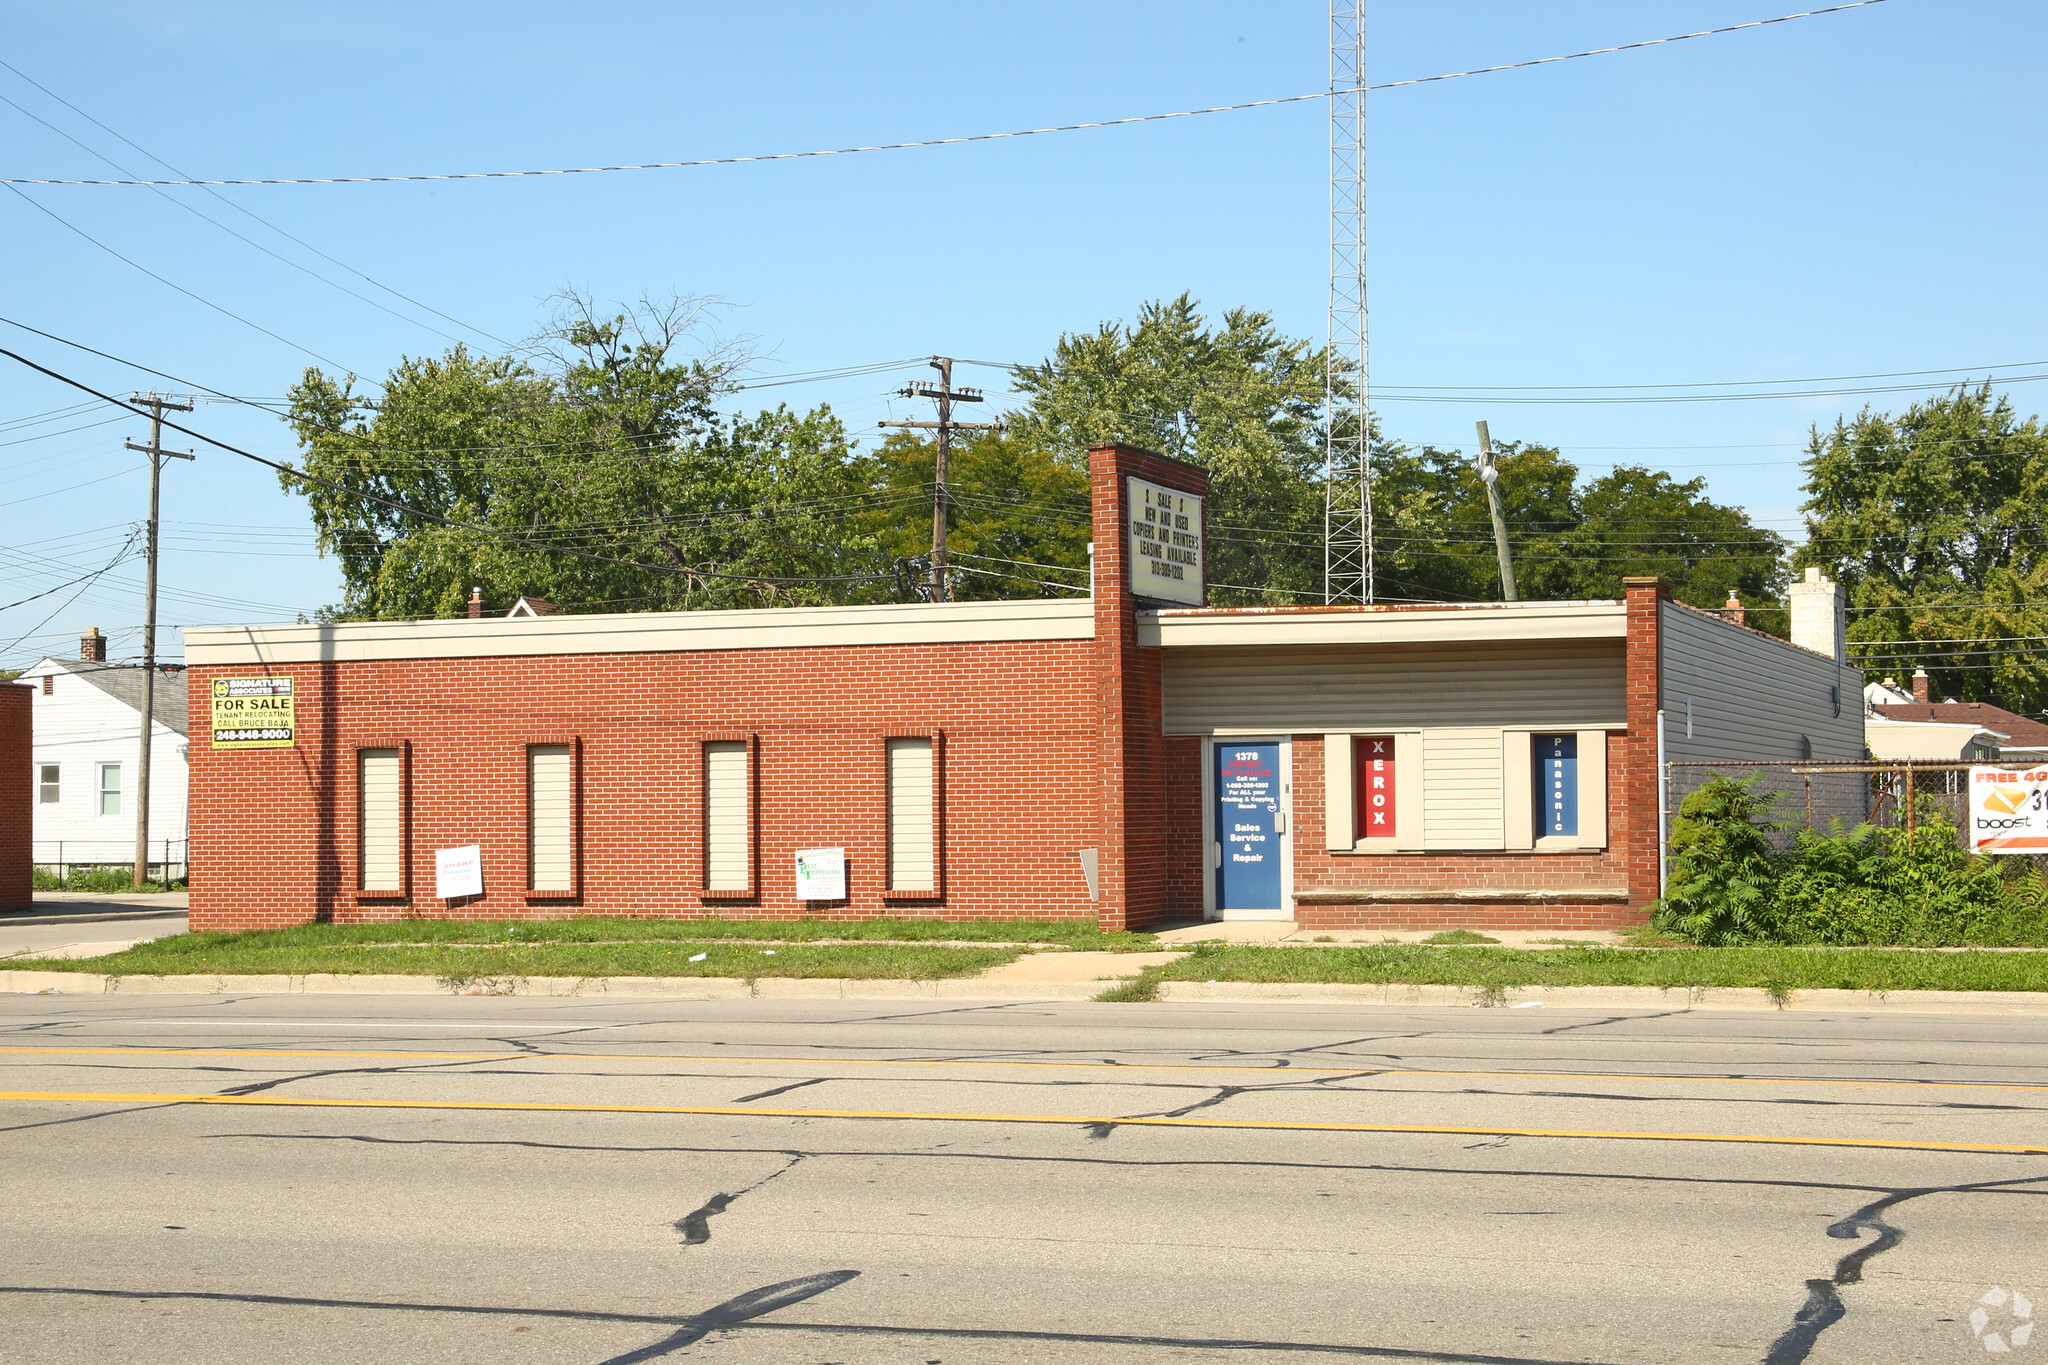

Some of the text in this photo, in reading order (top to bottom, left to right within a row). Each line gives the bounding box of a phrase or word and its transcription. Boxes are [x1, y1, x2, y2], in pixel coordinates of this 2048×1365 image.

[1158, 492, 1172, 509] SALE
[1145, 506, 1188, 531] NEW AND USED
[1133, 520, 1199, 550] COPIERS AND PRINTERS
[1140, 540, 1197, 566] LEASING AVAILABLE
[229, 679, 291, 688] SIGNATURE
[229, 687, 273, 695] ASSOCIATES
[216, 698, 290, 710] FOR SALE
[245, 710, 291, 718] RELOCATING
[216, 729, 290, 741] 248-948-9000
[1235, 752, 1258, 760] 1378
[1229, 760, 1262, 768] FOR HELP
[1976, 771, 2048, 783] FREE 4G
[1373, 741, 1385, 824] XEROX
[1554, 737, 1563, 832] Panasonic
[1977, 816, 2032, 829] boost
[1234, 824, 1260, 832] Sales
[1230, 834, 1266, 842] Service
[1244, 844, 1252, 852] &
[1233, 854, 1263, 863] Repair
[444, 860, 474, 868] SHARP
